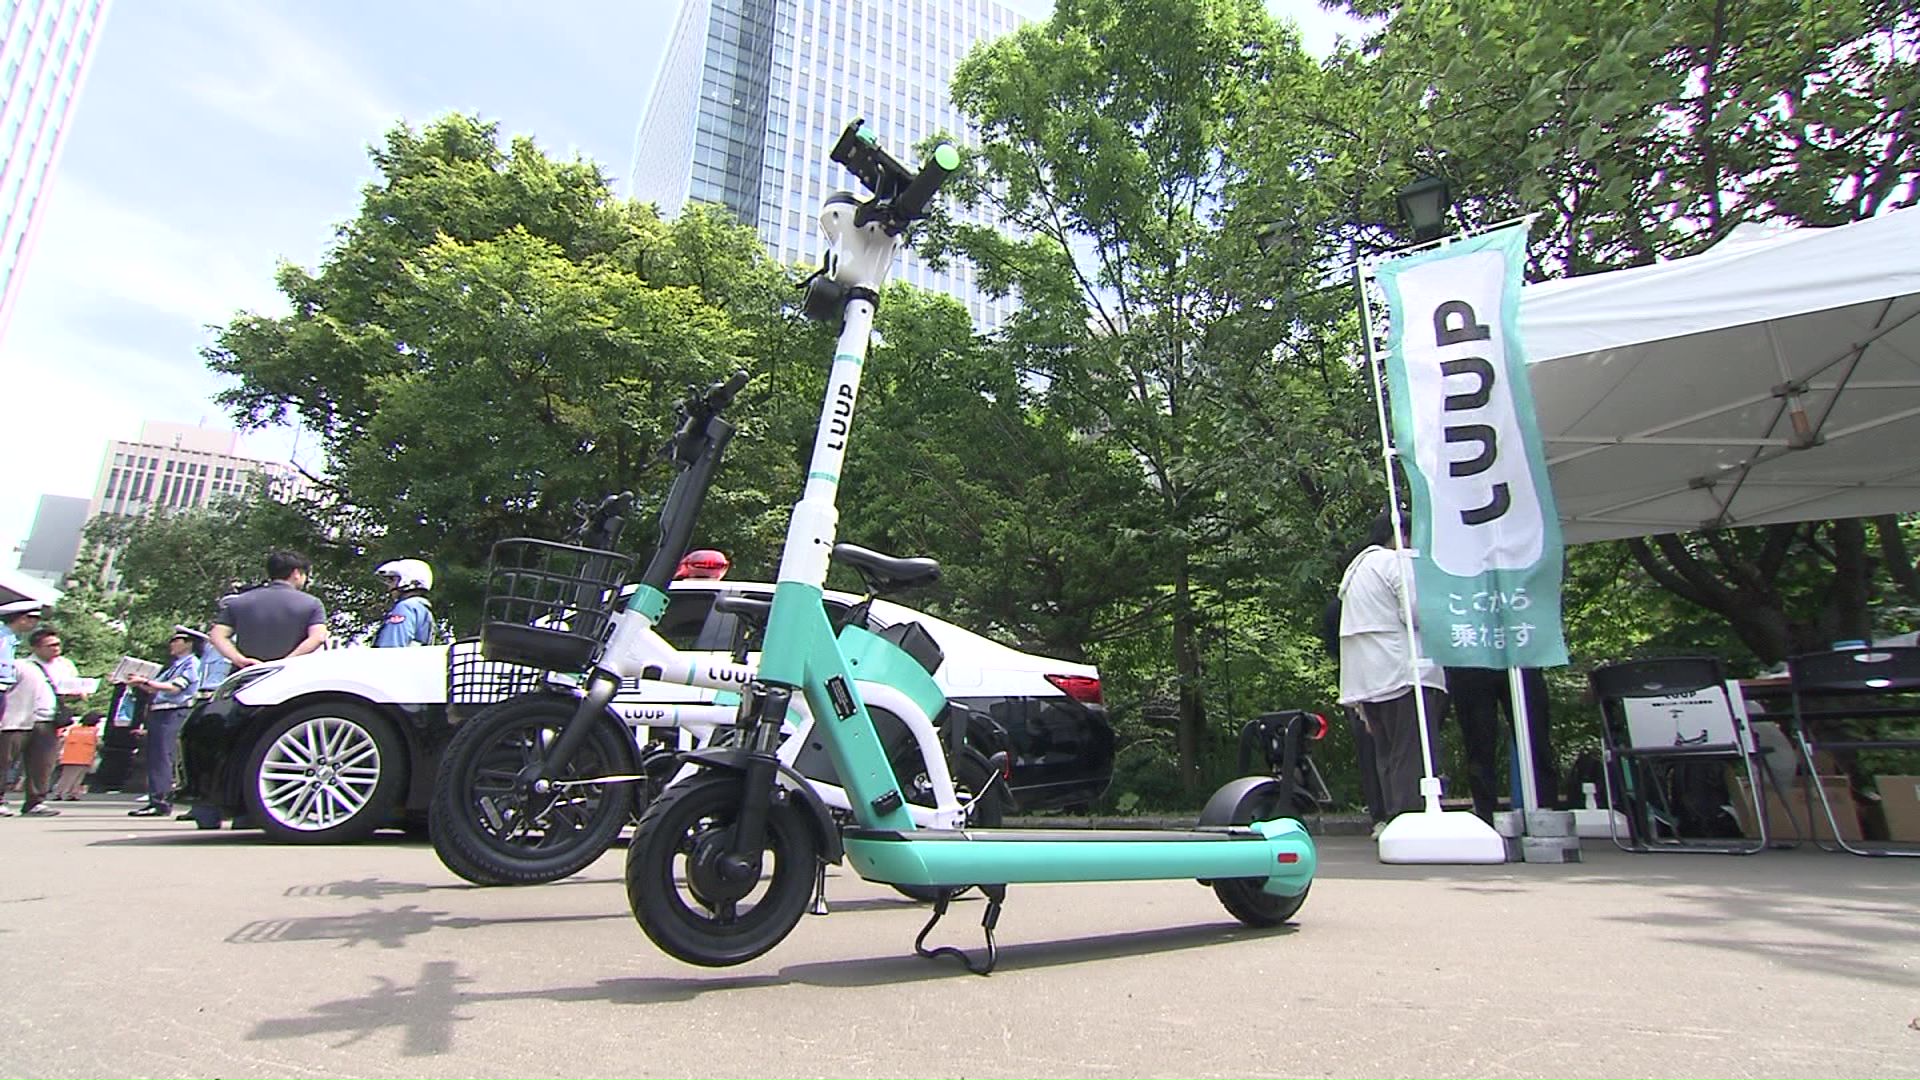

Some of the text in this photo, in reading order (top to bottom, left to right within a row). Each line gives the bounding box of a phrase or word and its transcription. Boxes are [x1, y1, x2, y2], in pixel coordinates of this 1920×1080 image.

[827, 384, 853, 450] LUUP
[1434, 300, 1511, 525] LUUP
[1449, 588, 1530, 615] ここから
[625, 709, 665, 719] LUUP
